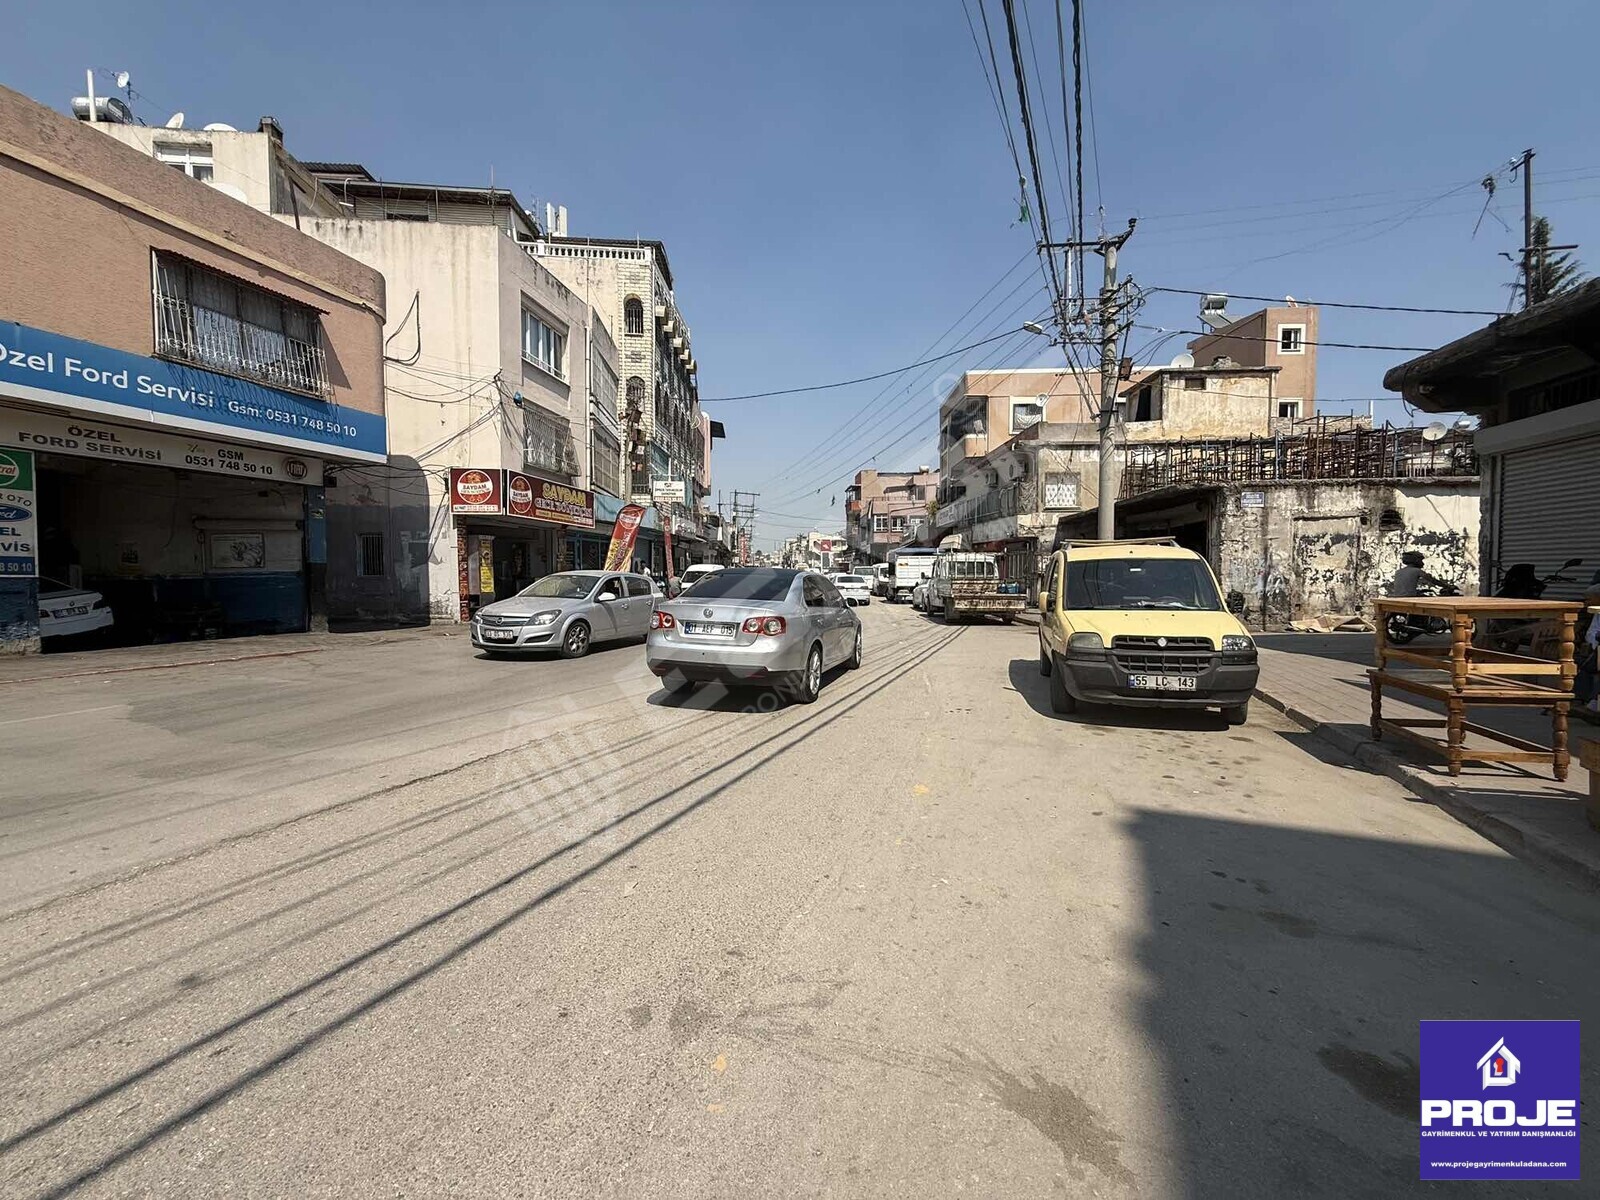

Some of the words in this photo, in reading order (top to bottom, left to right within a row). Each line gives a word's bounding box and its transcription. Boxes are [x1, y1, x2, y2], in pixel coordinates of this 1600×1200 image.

[65, 357, 129, 389] Ford
[137, 375, 214, 408] Servisi
[228, 401, 263, 418] Gsm:
[266, 409, 298, 425] 0531
[301, 416, 324, 431] 748
[327, 422, 341, 434] 50
[343, 425, 357, 437] 10
[18, 431, 79, 449] FORD
[67, 425, 121, 443] ÖZEL
[218, 449, 244, 461] GSM
[185, 455, 214, 467] 0531
[219, 460, 240, 471] 748
[244, 463, 257, 473] 50
[260, 465, 273, 475] 10
[7, 494, 32, 507] OTO
[542, 482, 586, 508] SAYDAM
[7, 562, 19, 572] 50
[21, 562, 32, 572] 10
[1135, 675, 1148, 686] 55
[1178, 677, 1194, 688] 143
